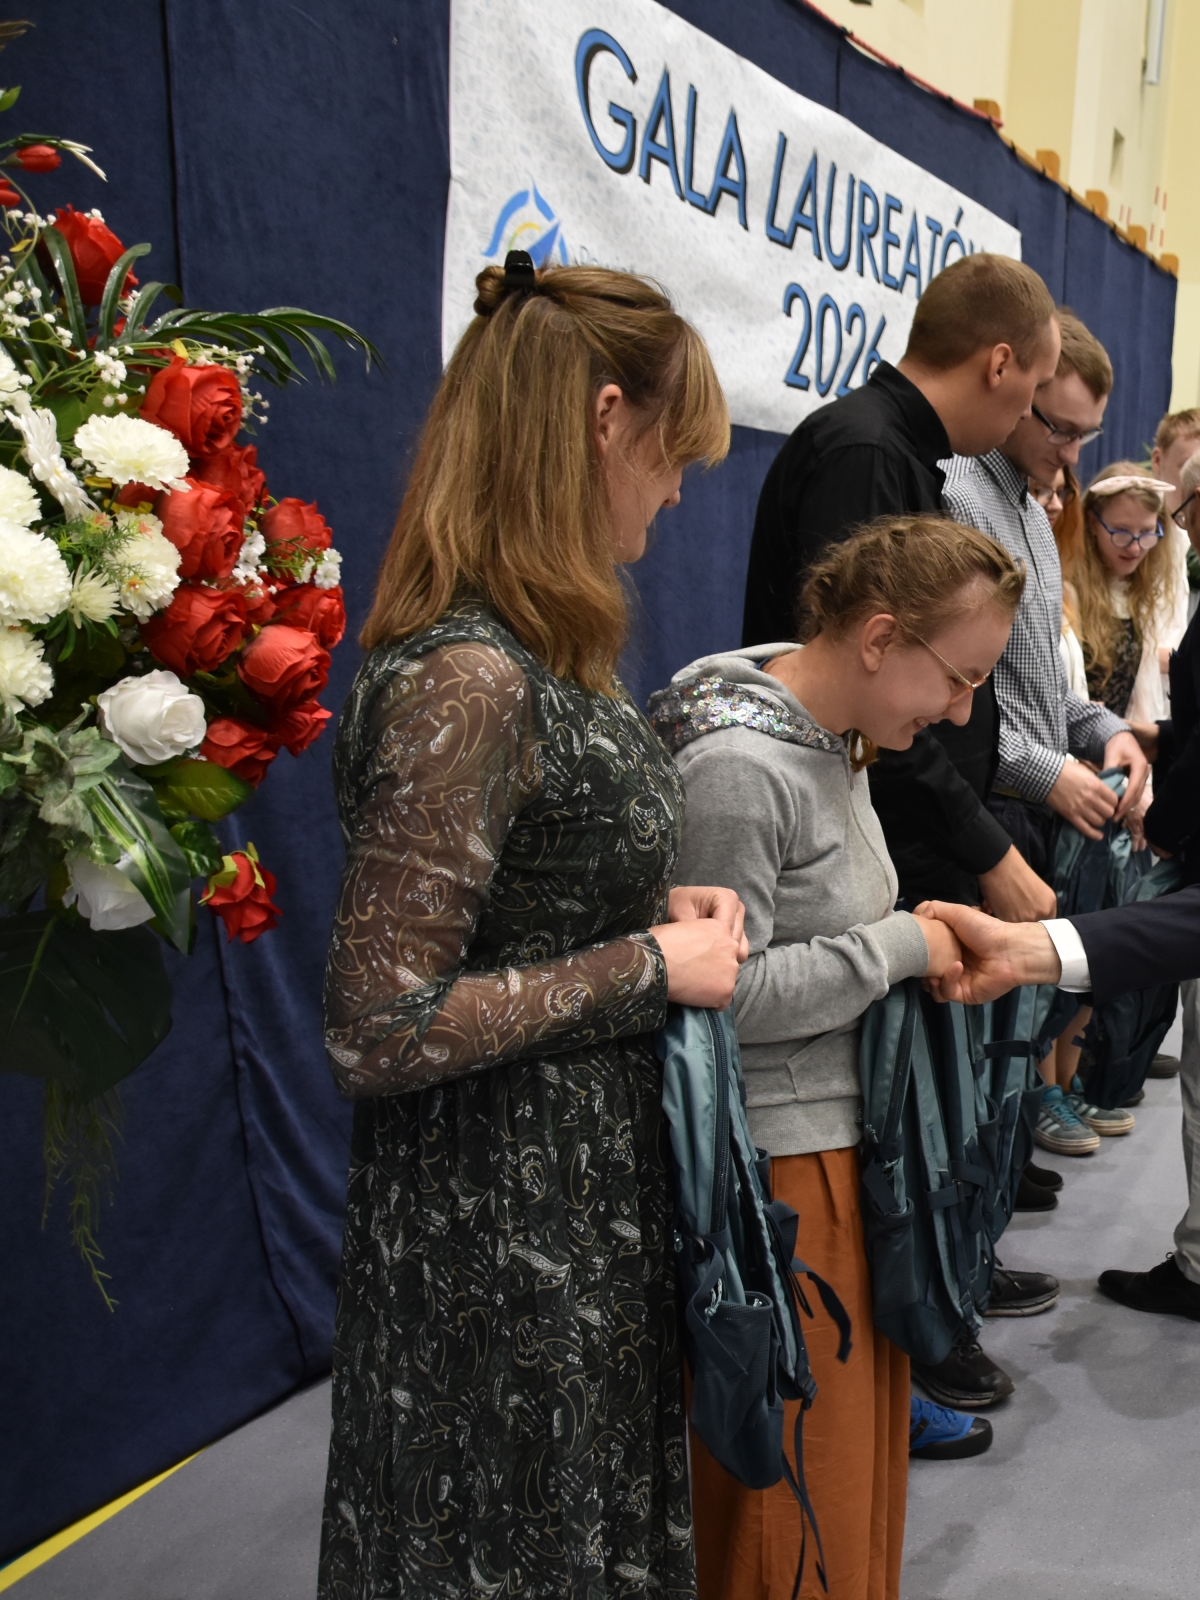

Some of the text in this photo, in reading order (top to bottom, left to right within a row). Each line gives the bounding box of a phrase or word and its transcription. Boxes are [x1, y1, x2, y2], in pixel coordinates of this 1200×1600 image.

[575, 27, 986, 300] GALA LAUREATÓ
[783, 281, 887, 398] 2026
